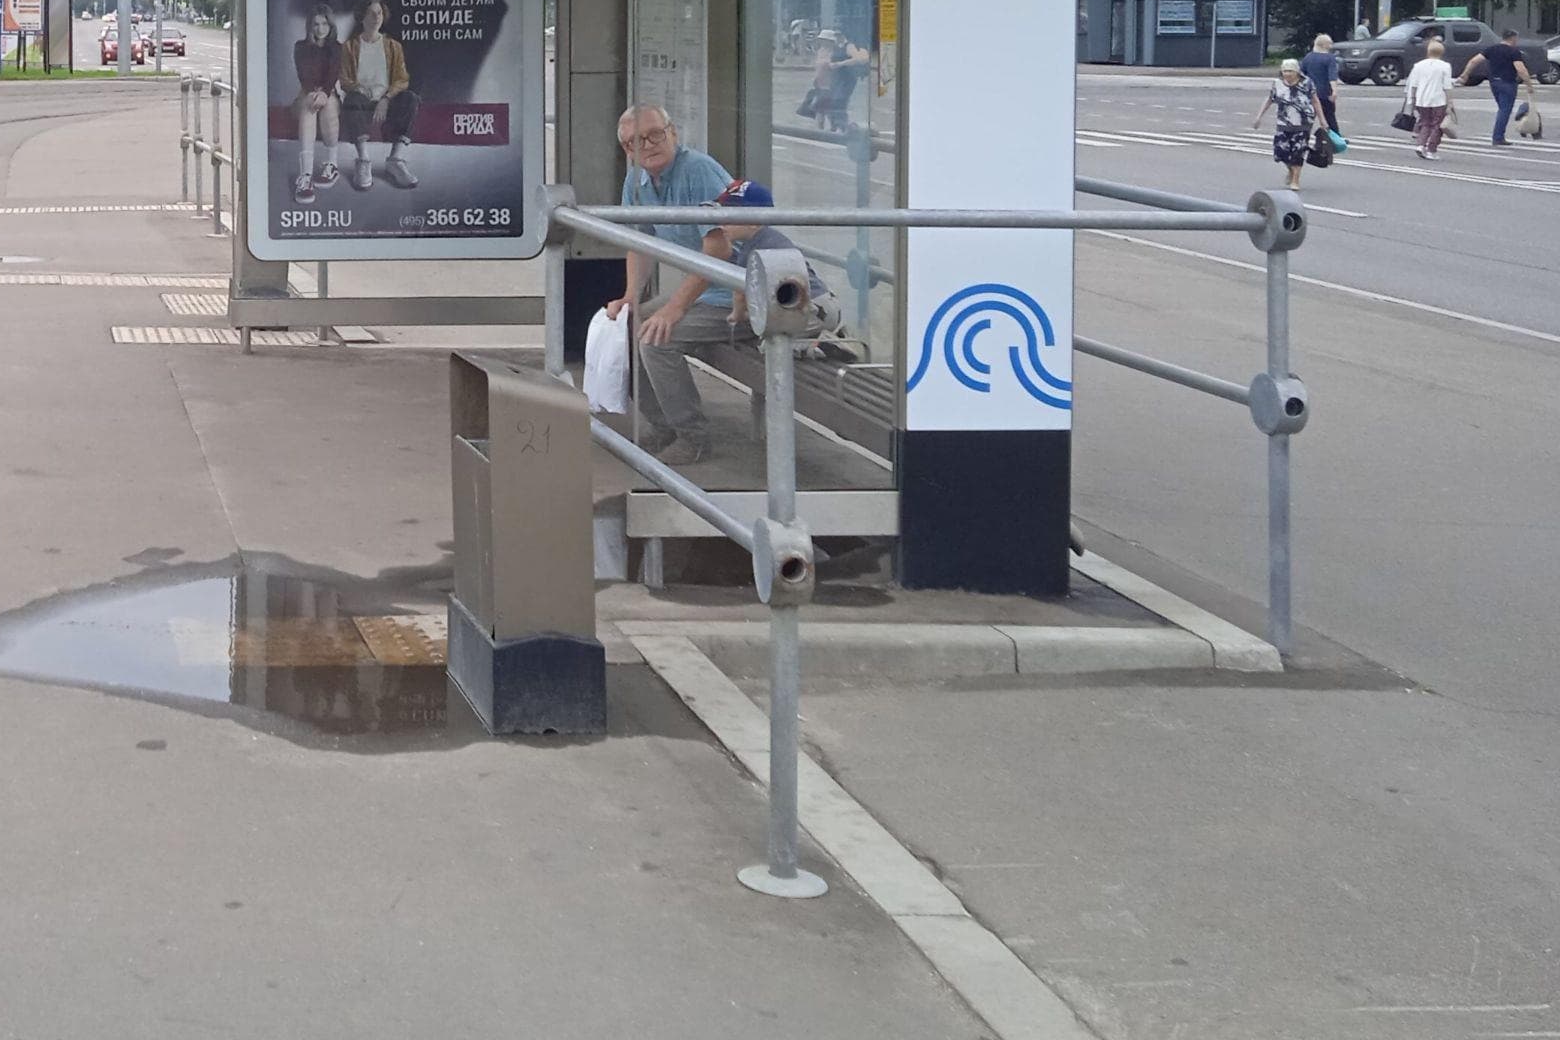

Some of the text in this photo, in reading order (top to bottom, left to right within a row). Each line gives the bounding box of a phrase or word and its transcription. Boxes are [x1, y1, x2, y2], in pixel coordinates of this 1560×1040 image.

[414, 10, 473, 26] СПИДЕ
[401, 28, 483, 41] ИЛИ ОН САМ
[453, 114, 495, 124] ПРОТИВ
[453, 123, 495, 135] СПИДА
[280, 210, 352, 227] SPID.RU
[399, 208, 511, 227] (495) 366 62 38
